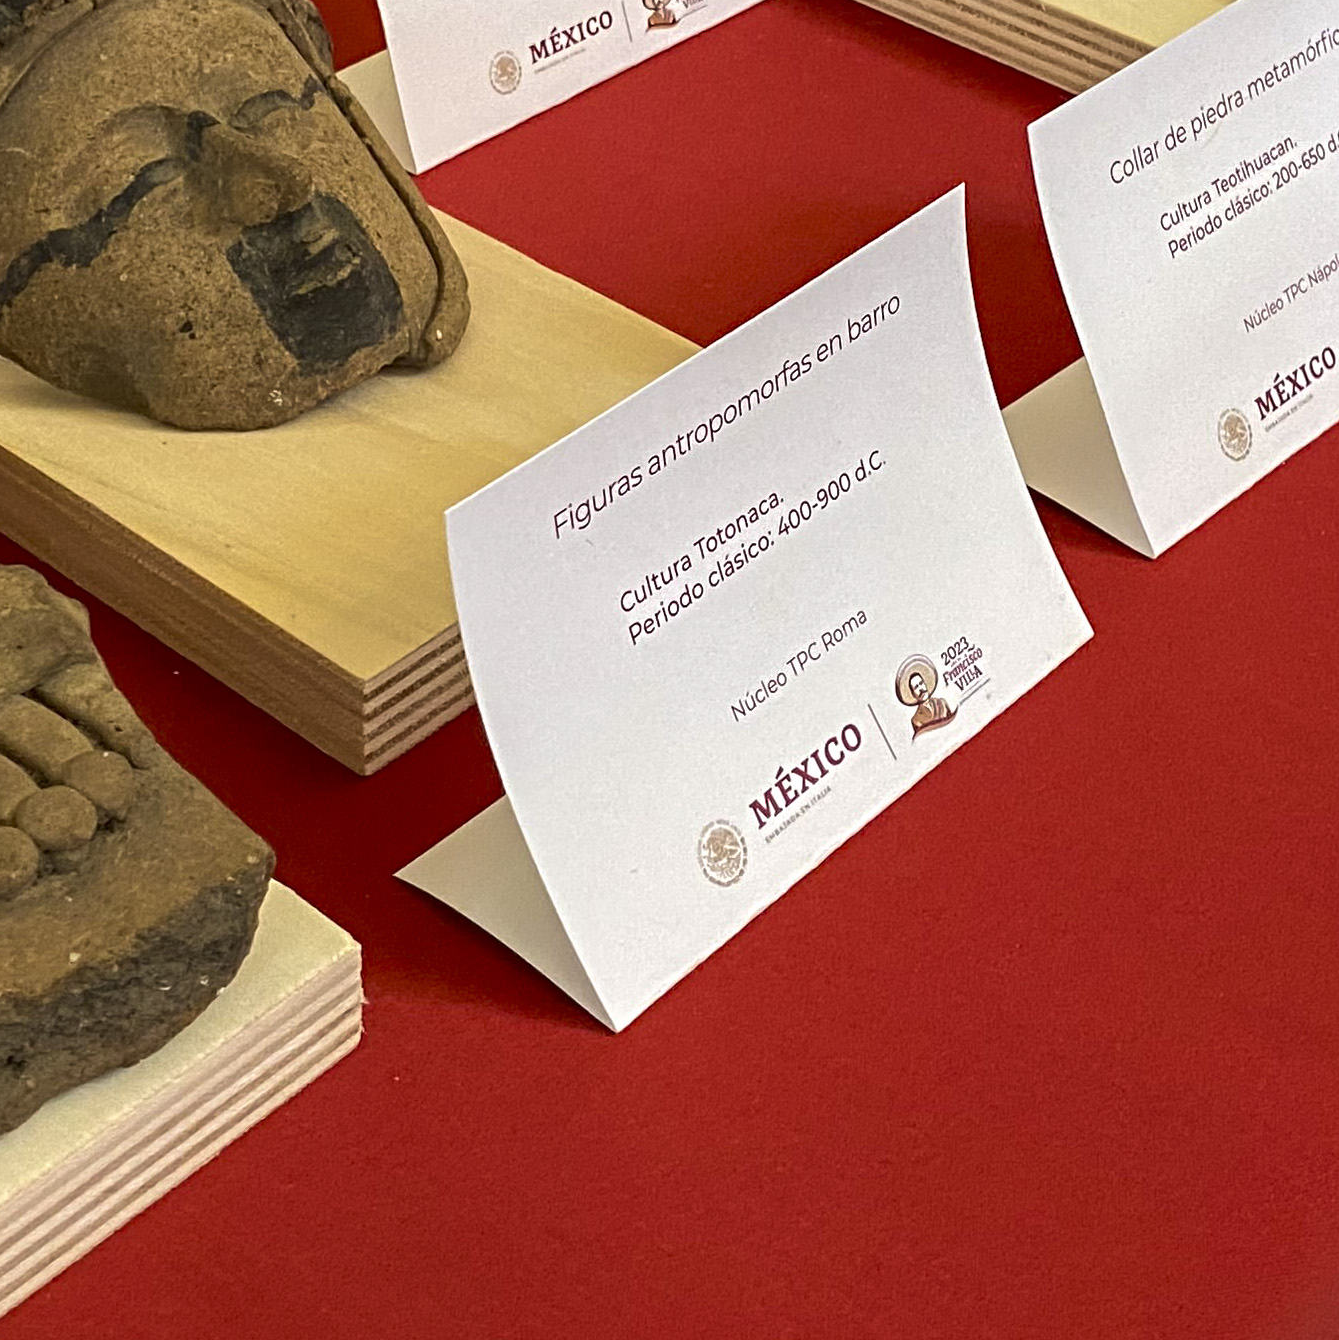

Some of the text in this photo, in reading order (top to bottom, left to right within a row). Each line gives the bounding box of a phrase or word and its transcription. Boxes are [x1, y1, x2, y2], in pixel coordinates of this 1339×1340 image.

[528, 10, 614, 65] MÉXICO
[1110, 140, 1160, 185] Collar
[1165, 125, 1188, 152] de
[1191, 90, 1245, 142] piedra
[1160, 137, 1298, 232] Cultura Teotihuacan.
[1168, 214, 1223, 260] Periodo
[1225, 181, 1274, 222] clásico:
[1272, 143, 1326, 191] 200-650
[1244, 298, 1284, 334] Núcleo
[1283, 278, 1308, 305] TPC
[554, 296, 901, 540] Figuras antropomorfas en barro
[1254, 346, 1337, 422] MÉXICO
[621, 493, 785, 613] Cultura Totonaca.
[629, 450, 887, 647] Periodo clásico: 400-900 d.C.
[731, 611, 868, 723] Núcleo TPC Roma
[941, 636, 969, 666] 2023
[749, 724, 862, 831] MÉXICO
